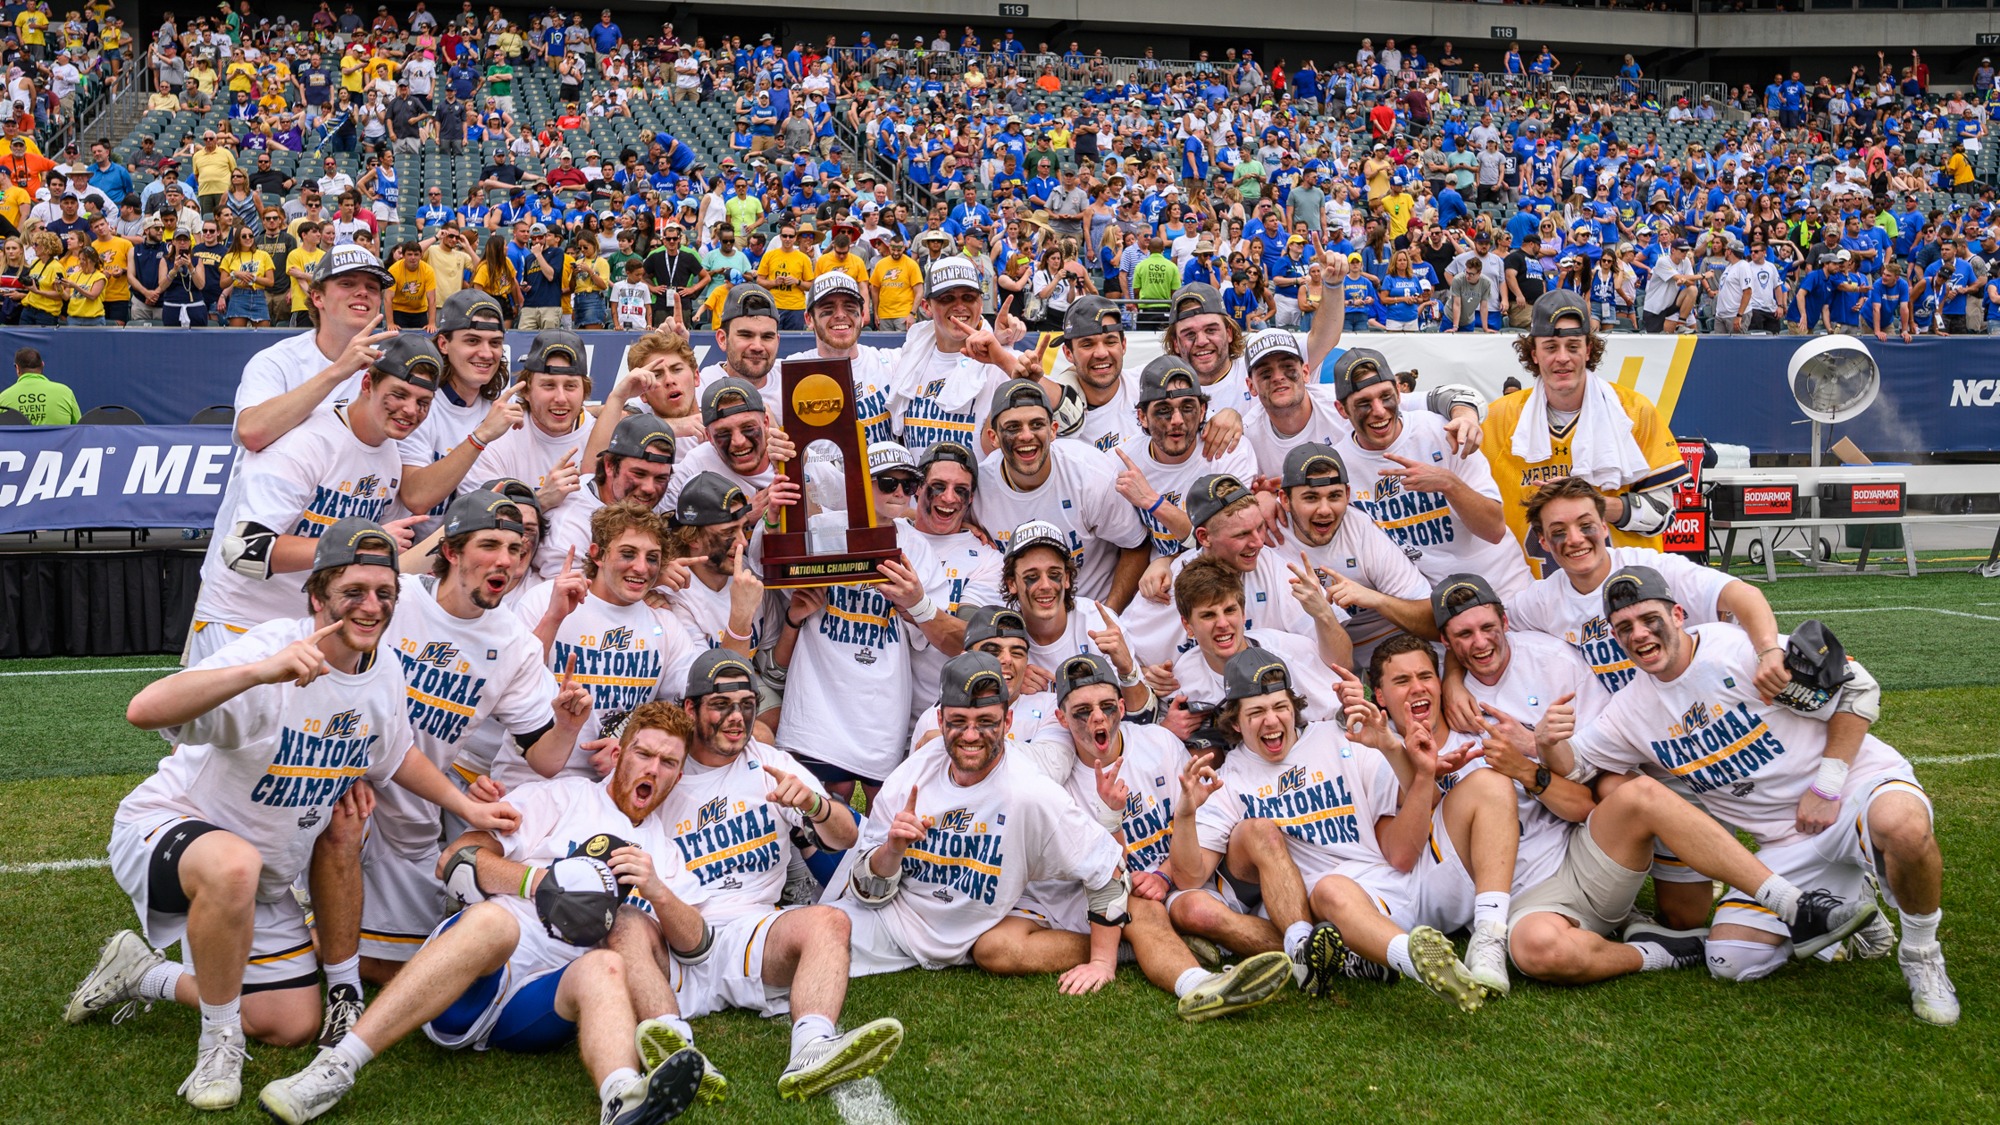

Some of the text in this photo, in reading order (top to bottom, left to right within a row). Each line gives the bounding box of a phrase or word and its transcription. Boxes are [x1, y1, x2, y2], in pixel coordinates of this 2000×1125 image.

[1004, 5, 1024, 16] 119
[1495, 28, 1513, 38] 118
[1981, 34, 2000, 44] 117
[1148, 264, 1166, 272] CSC
[931, 271, 978, 285] CHAMPIONS
[814, 276, 859, 293] CHAMPIONS
[1234, 310, 1242, 318] 21
[1249, 334, 1295, 358] CHAMPIONS
[18, 394, 46, 404] CSC
[18, 404, 46, 413] EVENT
[798, 397, 843, 416] NCAA
[339, 480, 352, 492] 20
[1356, 490, 1370, 500] 20
[1744, 492, 1791, 502] BODYARMOR
[1854, 490, 1899, 500] BODYARMOR
[1770, 500, 1788, 508] NCAA
[998, 531, 1010, 540] 20
[1666, 534, 1696, 544] NCAA
[789, 562, 869, 576] NATIONAL CHAMPION
[946, 568, 958, 578] 19
[580, 626, 645, 652] 20 MC 19
[400, 638, 470, 673] 20 MC 19
[304, 709, 369, 740] 20 MC 19
[1668, 724, 1683, 738] 20
[1710, 704, 1724, 718] 19
[1651, 702, 1764, 769] NATIONAL
[292, 768, 320, 776] DIVISION
[1258, 765, 1324, 798] 20 MC 19
[1239, 775, 1352, 820] NATIONAL
[676, 796, 746, 836] 20 MC 19
[940, 808, 974, 834] MC
[974, 822, 987, 834] 19
